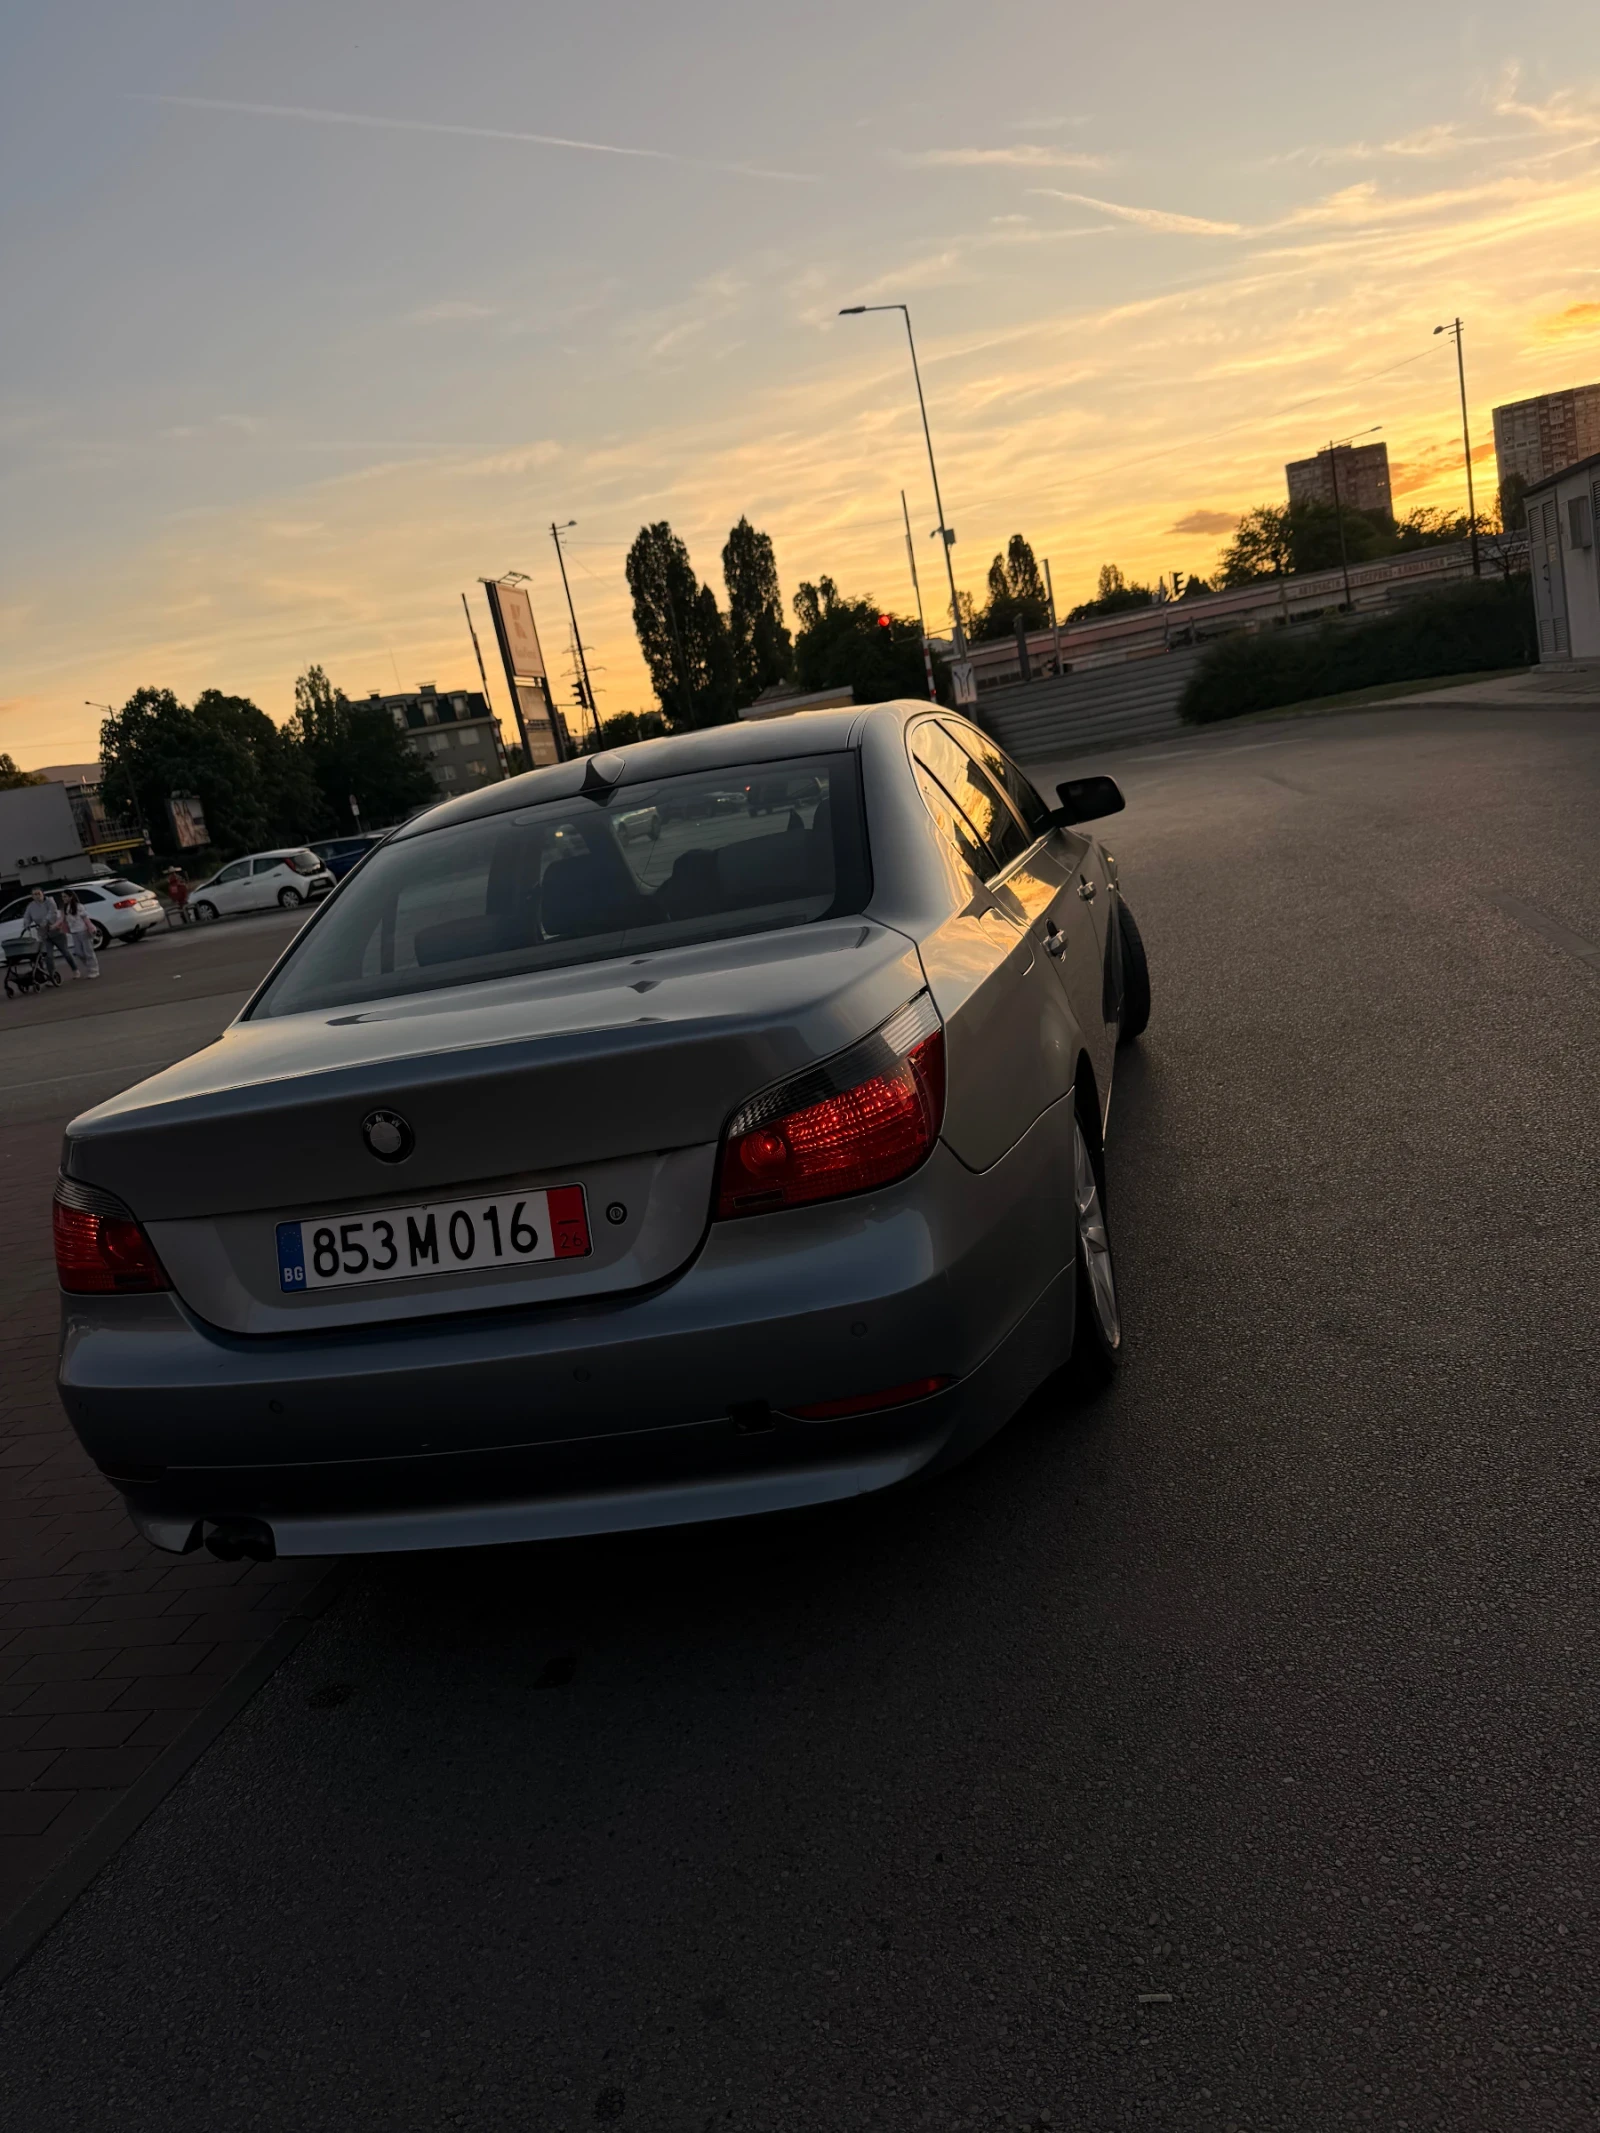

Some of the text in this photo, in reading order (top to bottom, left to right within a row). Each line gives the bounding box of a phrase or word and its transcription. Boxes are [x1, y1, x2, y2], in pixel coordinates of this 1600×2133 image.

[364, 1113, 402, 1133] BMW
[284, 1266, 304, 1283] BG
[559, 1231, 584, 1249] 26
